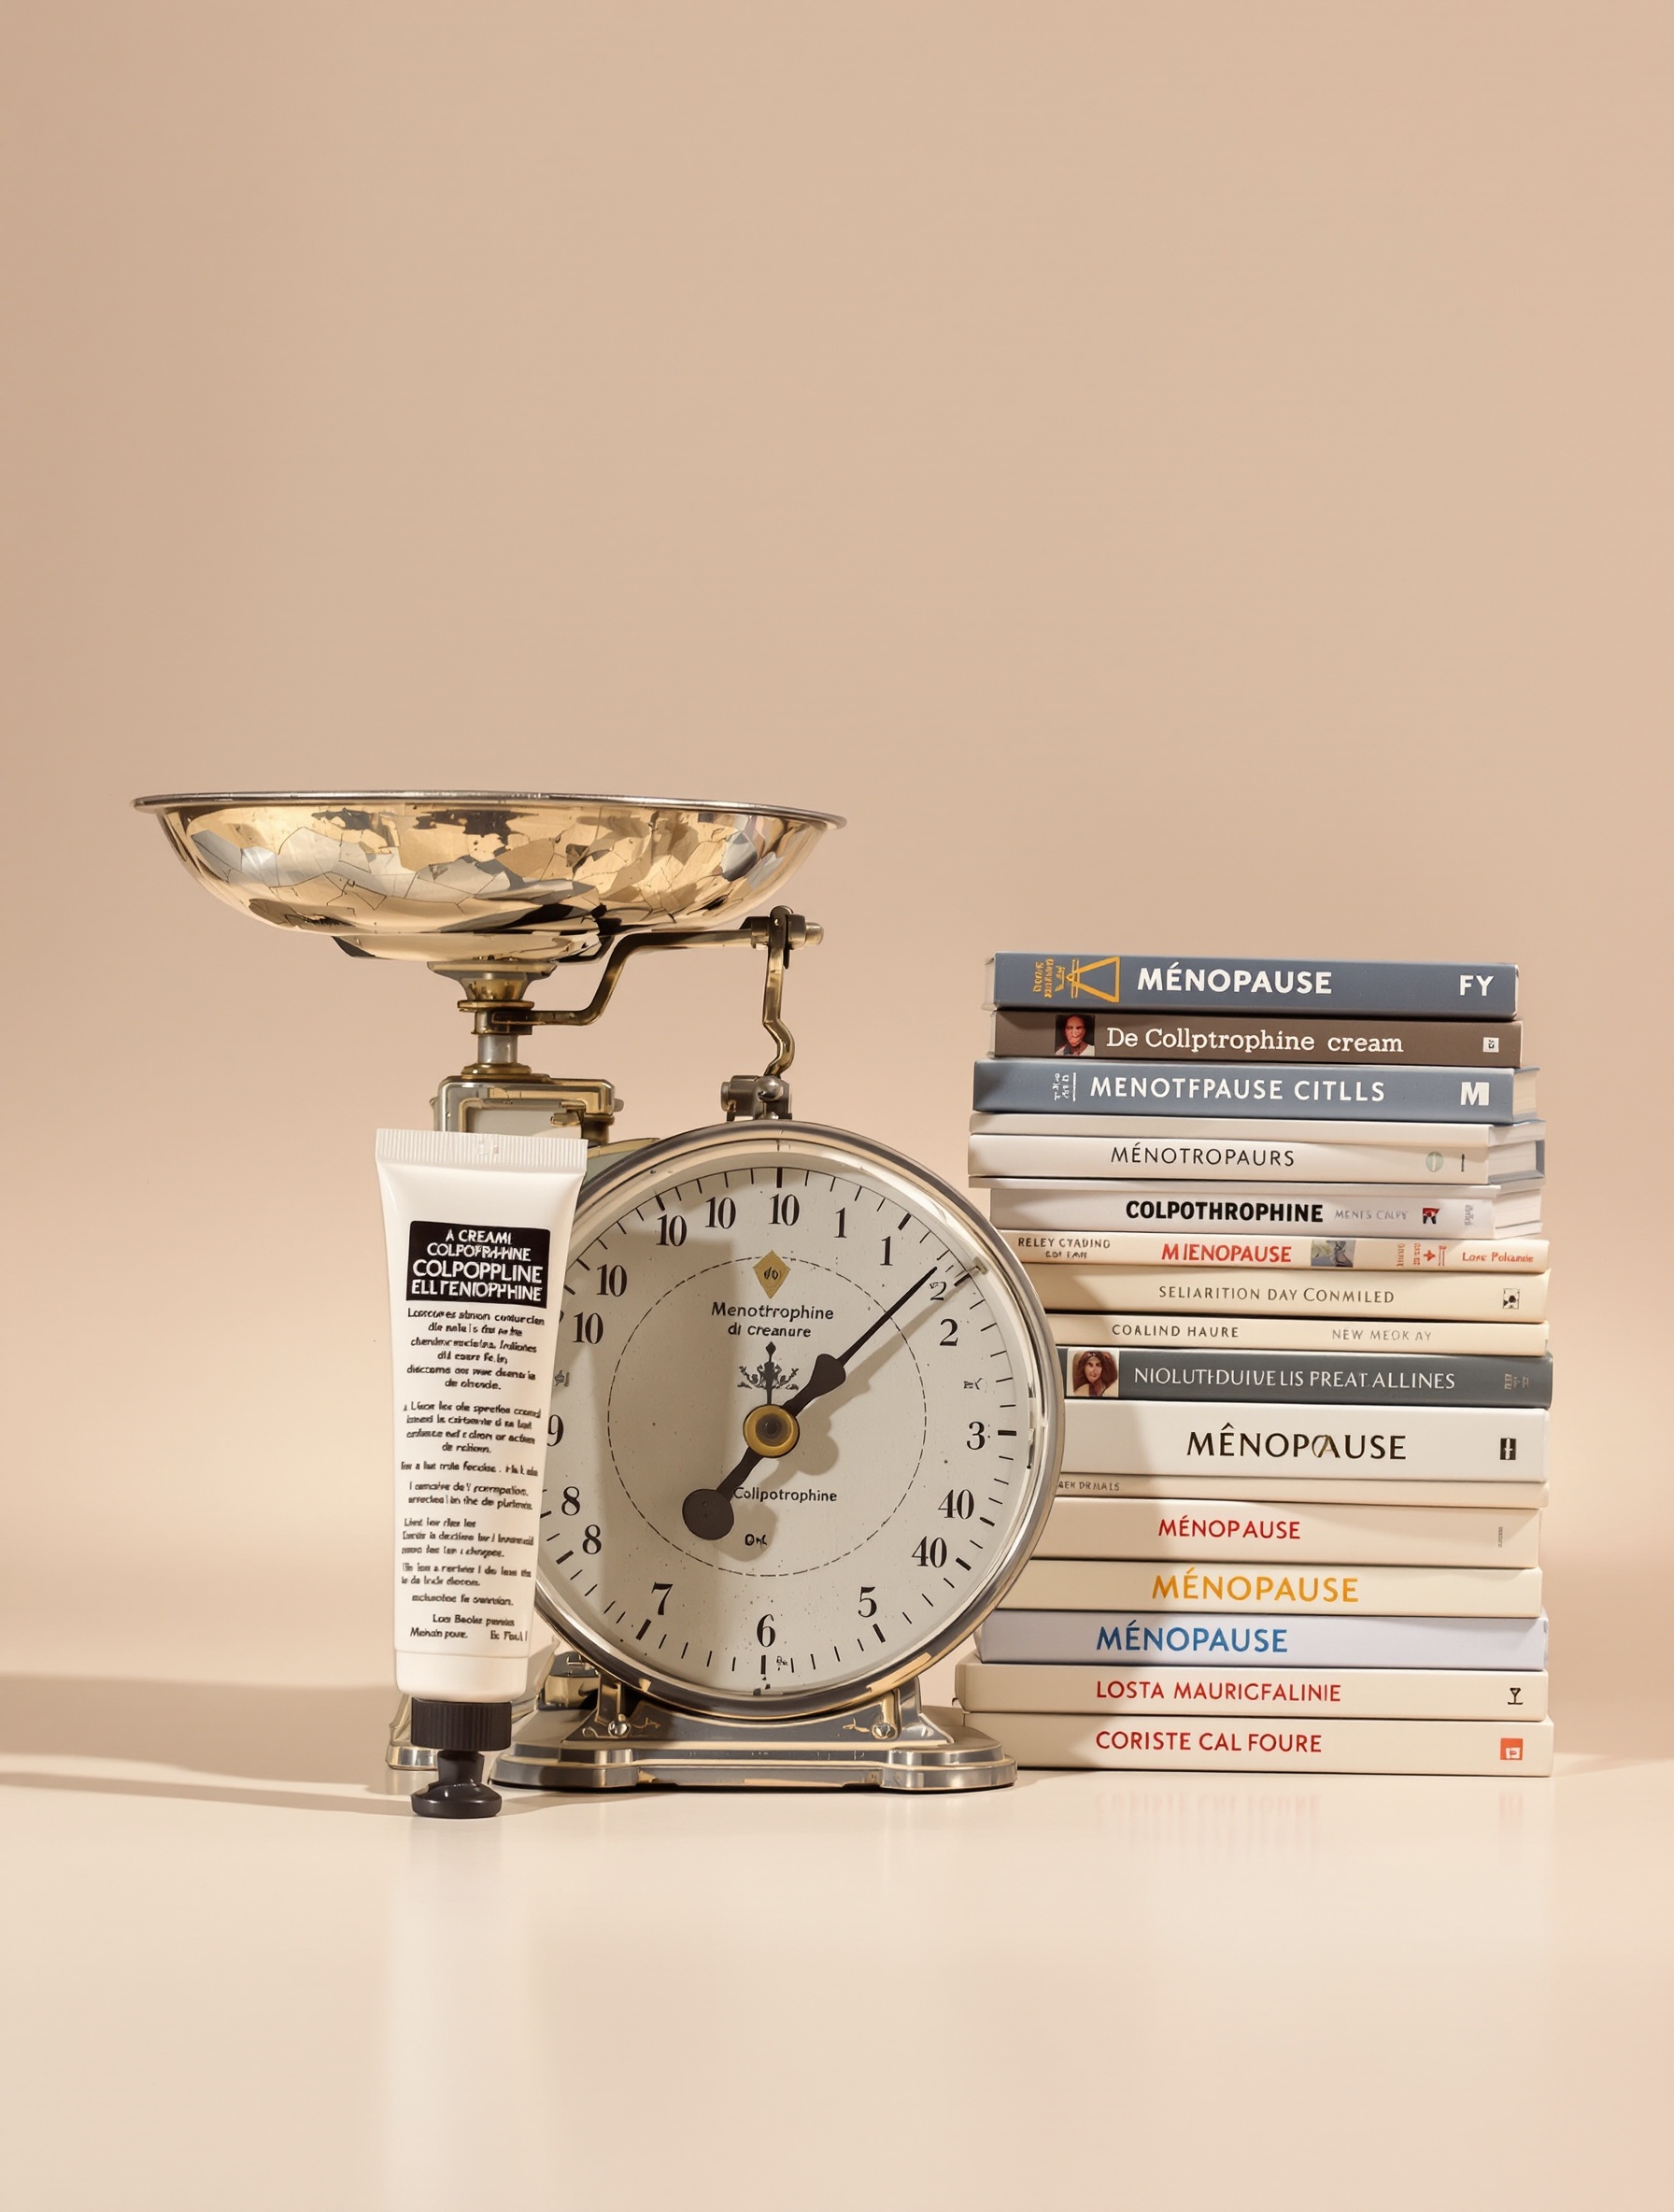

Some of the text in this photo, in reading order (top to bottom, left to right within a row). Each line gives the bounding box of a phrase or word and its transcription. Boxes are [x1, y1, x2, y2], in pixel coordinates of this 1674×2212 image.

[1138, 961, 1332, 993] MÉNOPAUSE
[1460, 975, 1494, 996] FY
[1107, 1028, 1138, 1047] De
[1327, 1038, 1404, 1052] cream
[1112, 1142, 1295, 1167] MÉNOTROPAURS
[704, 1197, 736, 1229] 10
[769, 1194, 800, 1226] 10
[834, 1207, 847, 1239] 1
[1127, 1201, 1323, 1222] COLPOTHROPHINE
[656, 1214, 687, 1246] 10
[880, 1236, 893, 1266] 1
[413, 1259, 544, 1283] COLPOPPLINE
[597, 1264, 627, 1297] 10
[1269, 1289, 1297, 1300] DAY
[573, 1312, 603, 1344] 10
[940, 1319, 958, 1346] 2
[547, 1414, 563, 1446] 9
[966, 1421, 986, 1450] 3
[560, 1486, 581, 1516] 8
[938, 1489, 974, 1519] 40
[583, 1524, 602, 1554] 8
[1158, 1515, 1300, 1538] MÉNOPAUSE
[912, 1537, 947, 1567] 40
[652, 1581, 673, 1615] 7
[1152, 1566, 1360, 1602] MÉNOPAUSE
[858, 1587, 877, 1617] 5
[757, 1614, 775, 1647] 6
[1096, 1619, 1287, 1652] MÉNOPAUSE
[1097, 1680, 1164, 1698] LOSTA
[1096, 1731, 1191, 1750] CORISTE
